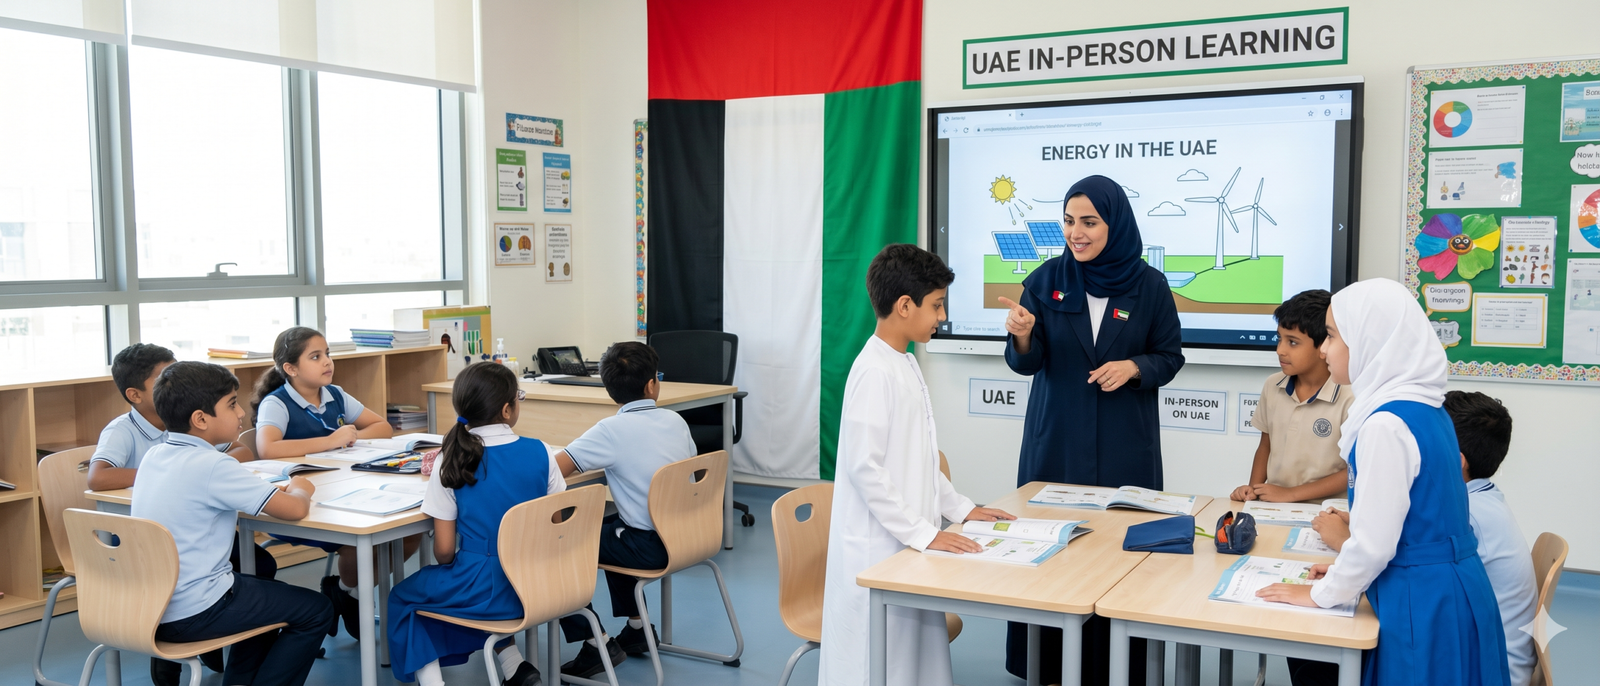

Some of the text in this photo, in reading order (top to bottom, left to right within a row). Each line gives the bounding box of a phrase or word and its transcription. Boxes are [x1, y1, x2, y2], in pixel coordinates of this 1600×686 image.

[972, 24, 1335, 75] UAE IN-PERSON LEARNING
[1042, 139, 1217, 161] ENERGY IN THE UAE
[982, 389, 1016, 406] UAE
[1164, 397, 1219, 409] IN-PERSON
[1172, 409, 1210, 421] ON UAE
